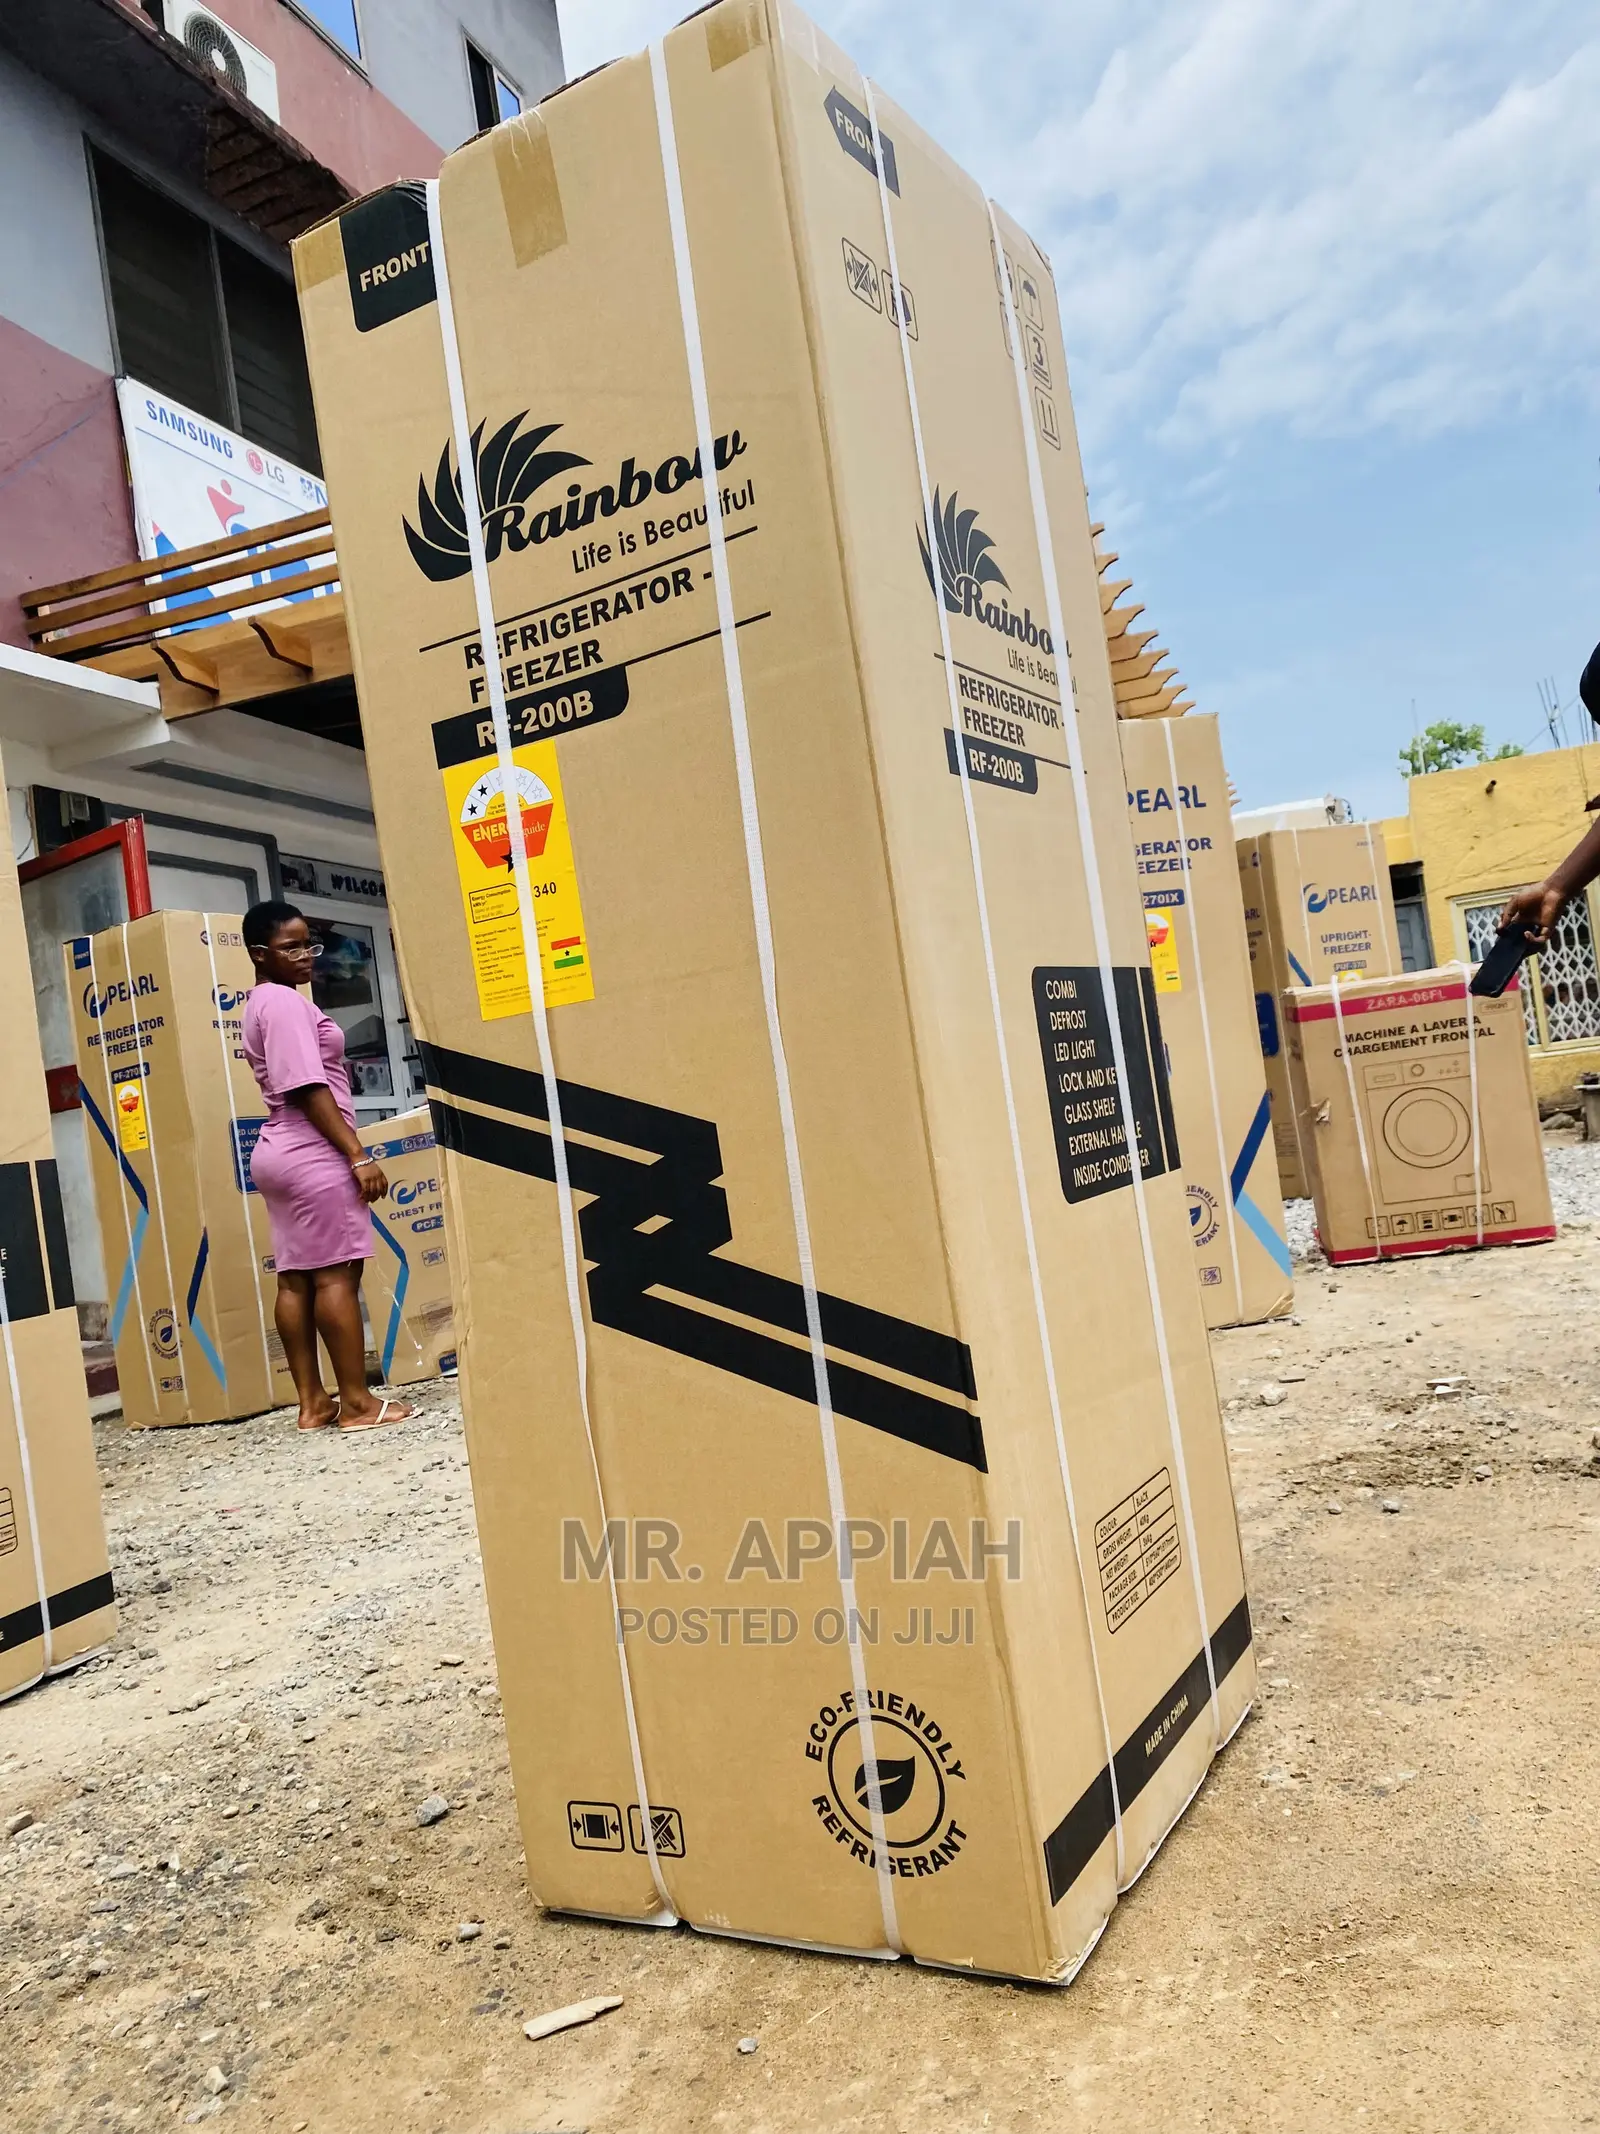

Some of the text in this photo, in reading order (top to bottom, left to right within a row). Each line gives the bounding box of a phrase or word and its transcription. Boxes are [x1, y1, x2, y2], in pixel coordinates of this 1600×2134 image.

[835, 107, 885, 159] FRON
[359, 241, 429, 293] FRONT
[146, 400, 234, 460] SAMSUNG
[266, 460, 285, 484] LG
[483, 429, 747, 563] Rainbow
[572, 478, 755, 574] Life is Beauiful
[1007, 648, 1025, 674] Life
[1026, 656, 1035, 678] is
[958, 673, 1060, 730] REFRIGERATOR
[476, 690, 594, 748] R-200B
[963, 706, 1026, 747] FREEZER
[968, 748, 1024, 784] RF-200B
[534, 882, 557, 898] 340
[1323, 942, 1372, 956] FREEZER
[107, 973, 160, 1006] PEARL
[1045, 980, 1078, 1000] COMBI
[1050, 1010, 1087, 1031] DEFROST
[1344, 1026, 1406, 1043] MACHINE
[1410, 1024, 1420, 1034] A
[1424, 1017, 1468, 1032] LAVER
[1054, 1039, 1096, 1062] LED LIGHT
[1058, 1066, 1117, 1094] LOCK AND KE
[1064, 1096, 1116, 1124] GLASS SHELF
[1068, 1128, 1111, 1156] EXTERNAL
[1073, 1148, 1151, 1188] INSIDE CONDEER
[389, 1206, 424, 1220] CHEST
[1145, 1694, 1188, 1758] MADE IN CHINA
